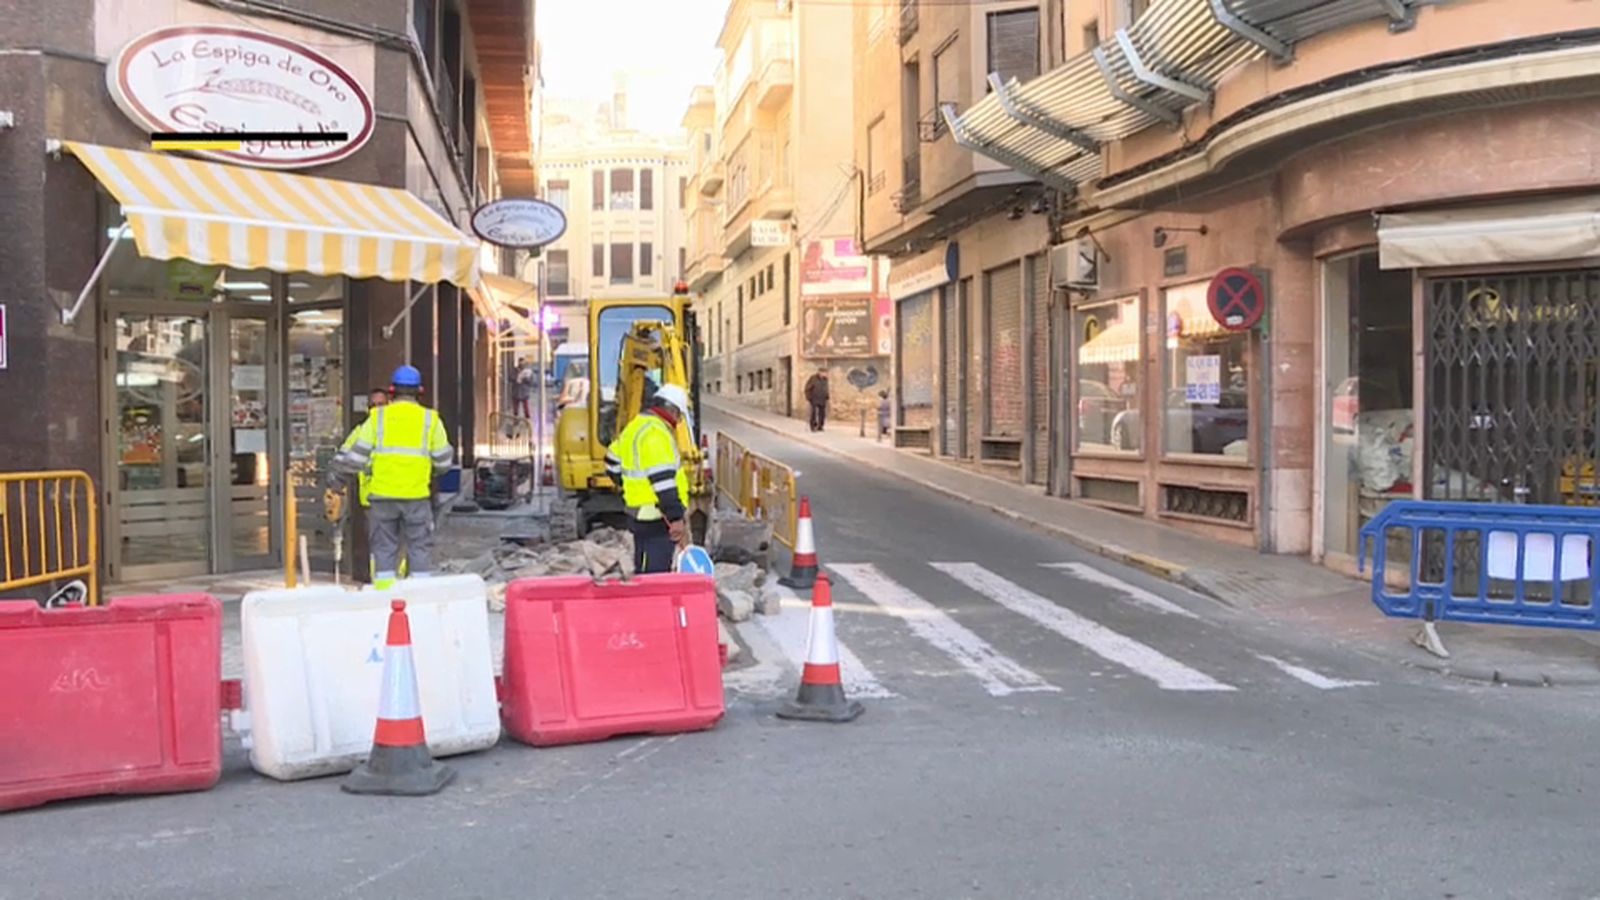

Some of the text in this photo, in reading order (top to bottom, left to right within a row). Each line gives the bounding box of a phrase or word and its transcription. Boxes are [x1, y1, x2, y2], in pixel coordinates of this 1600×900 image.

[151, 40, 347, 103] La Espiga de Oro
